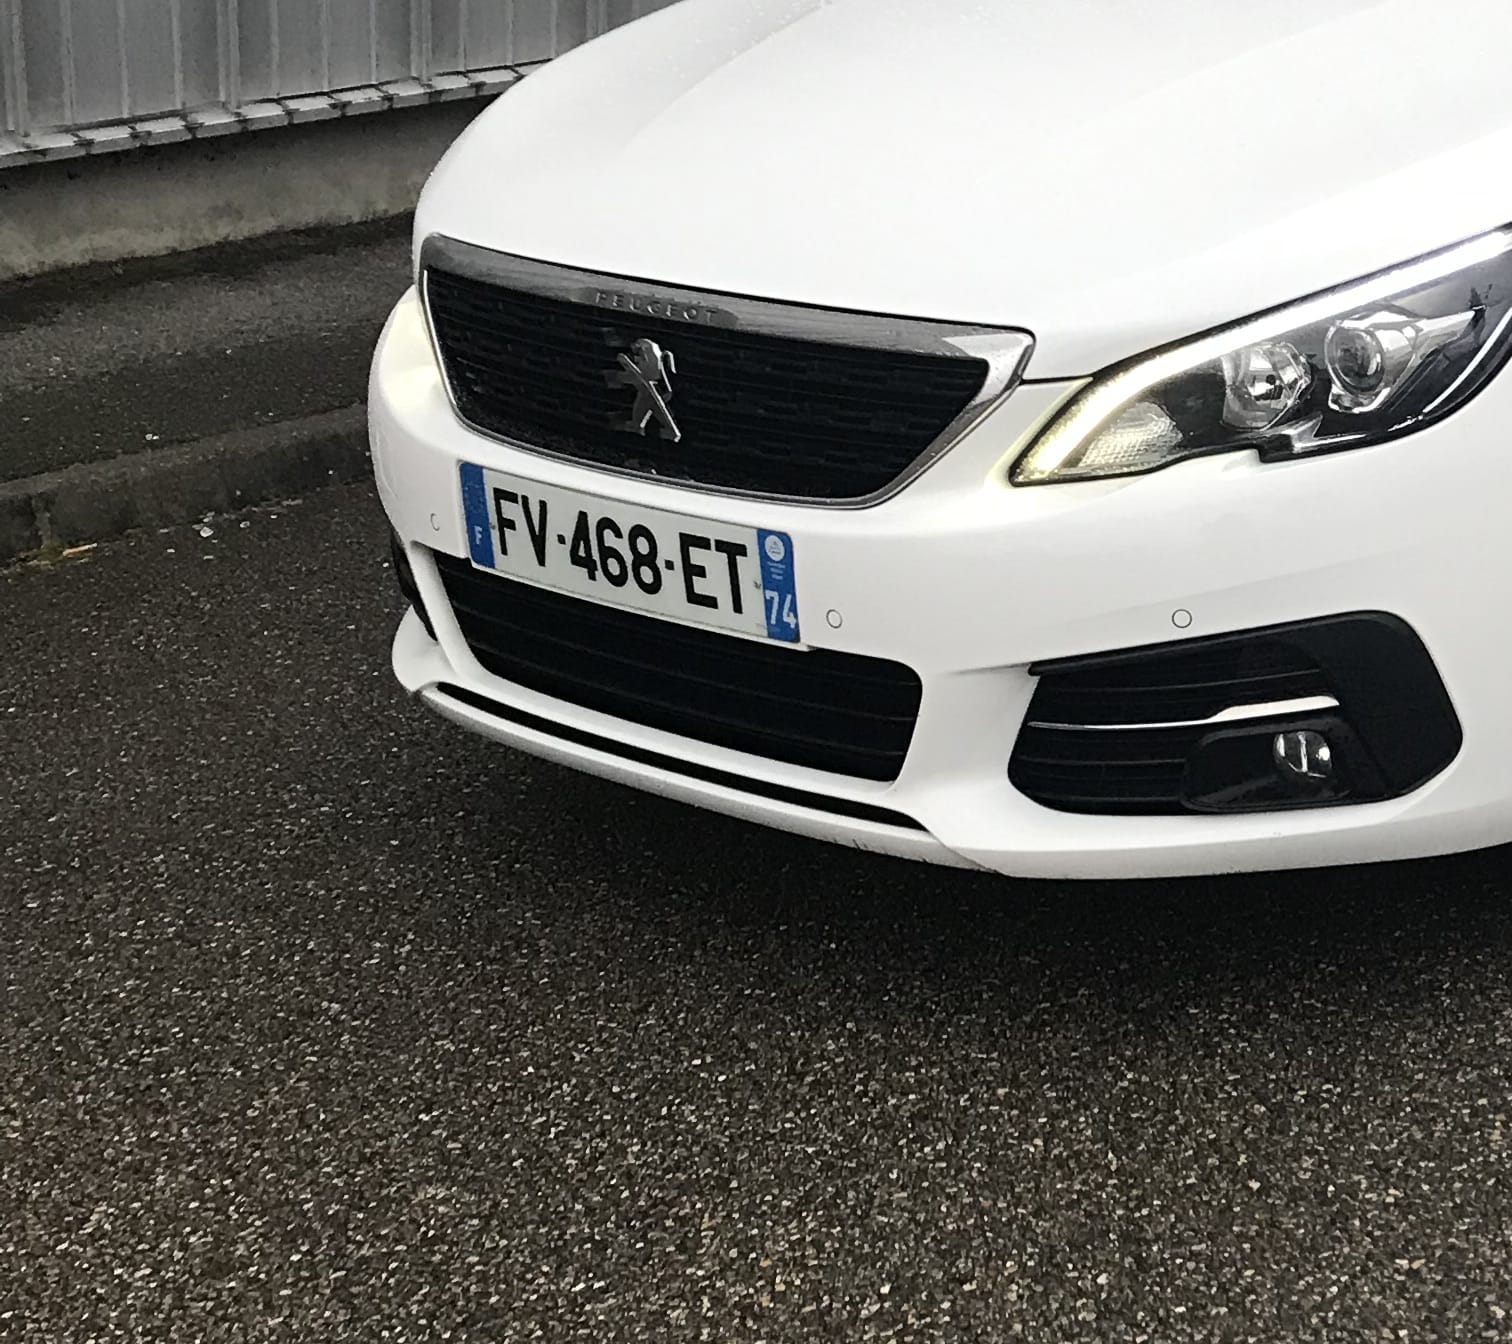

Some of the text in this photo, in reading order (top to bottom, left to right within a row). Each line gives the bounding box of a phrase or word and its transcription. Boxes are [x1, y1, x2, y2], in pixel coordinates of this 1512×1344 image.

[595, 291, 717, 325] PEUGEOT
[474, 526, 483, 545] F
[765, 589, 797, 629] 74
